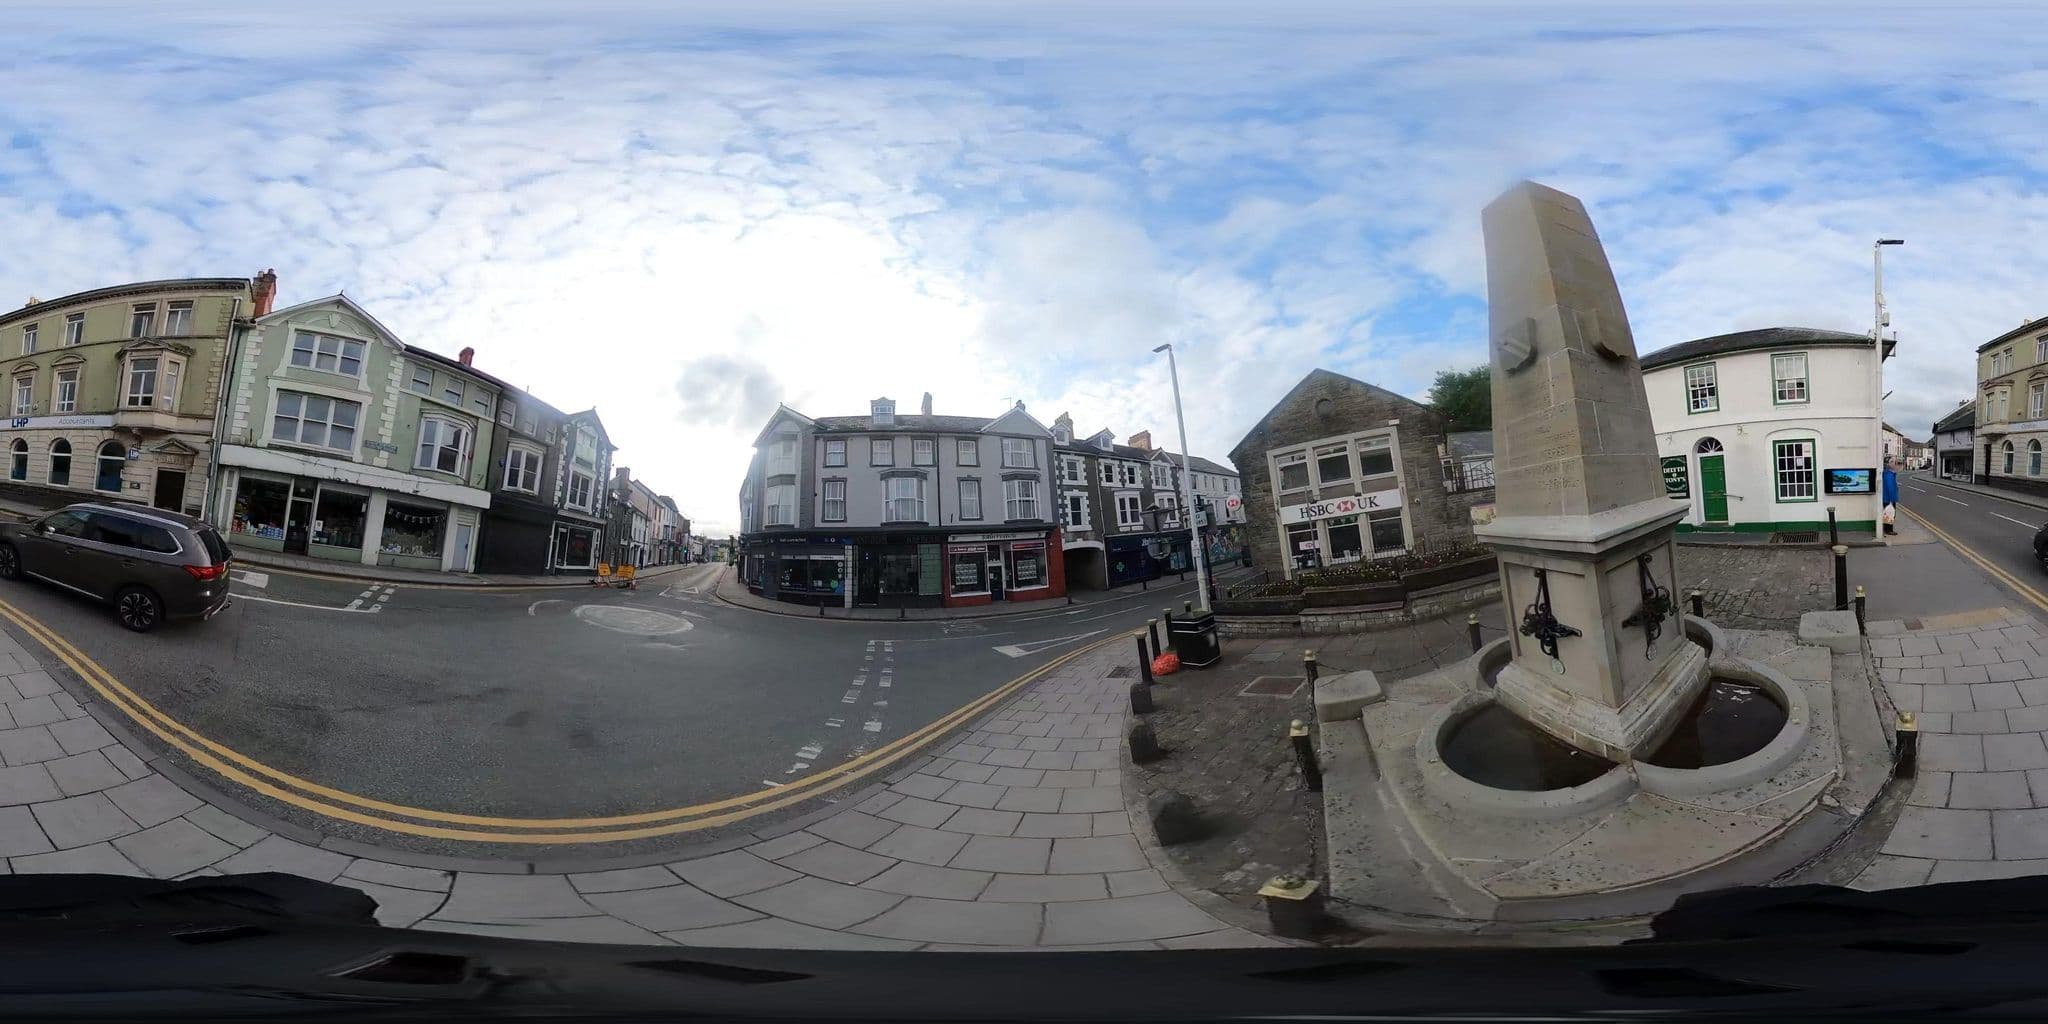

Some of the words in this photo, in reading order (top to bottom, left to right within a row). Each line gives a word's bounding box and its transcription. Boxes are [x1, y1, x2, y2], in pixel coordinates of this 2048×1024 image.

[11, 418, 29, 428] LHP
[58, 418, 96, 426] Accountants
[1300, 503, 1335, 519] HSBC
[1357, 496, 1380, 510] UK
